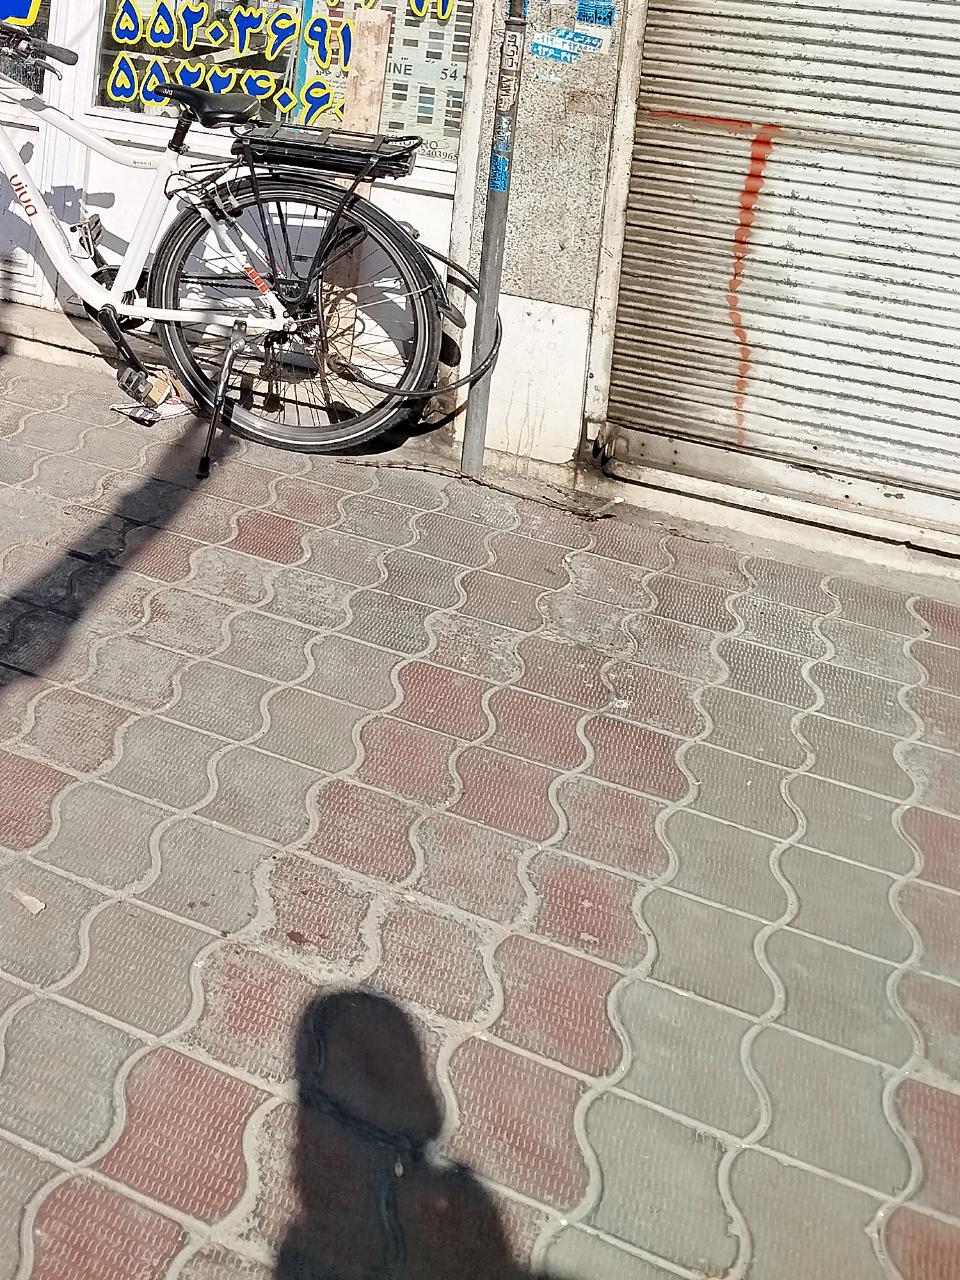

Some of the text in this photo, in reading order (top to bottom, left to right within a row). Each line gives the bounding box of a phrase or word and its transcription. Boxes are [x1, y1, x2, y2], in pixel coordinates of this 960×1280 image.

[107, 51, 345, 126] ۵۵۲۲۴۰۶
[388, 62, 458, 81] INE 54
